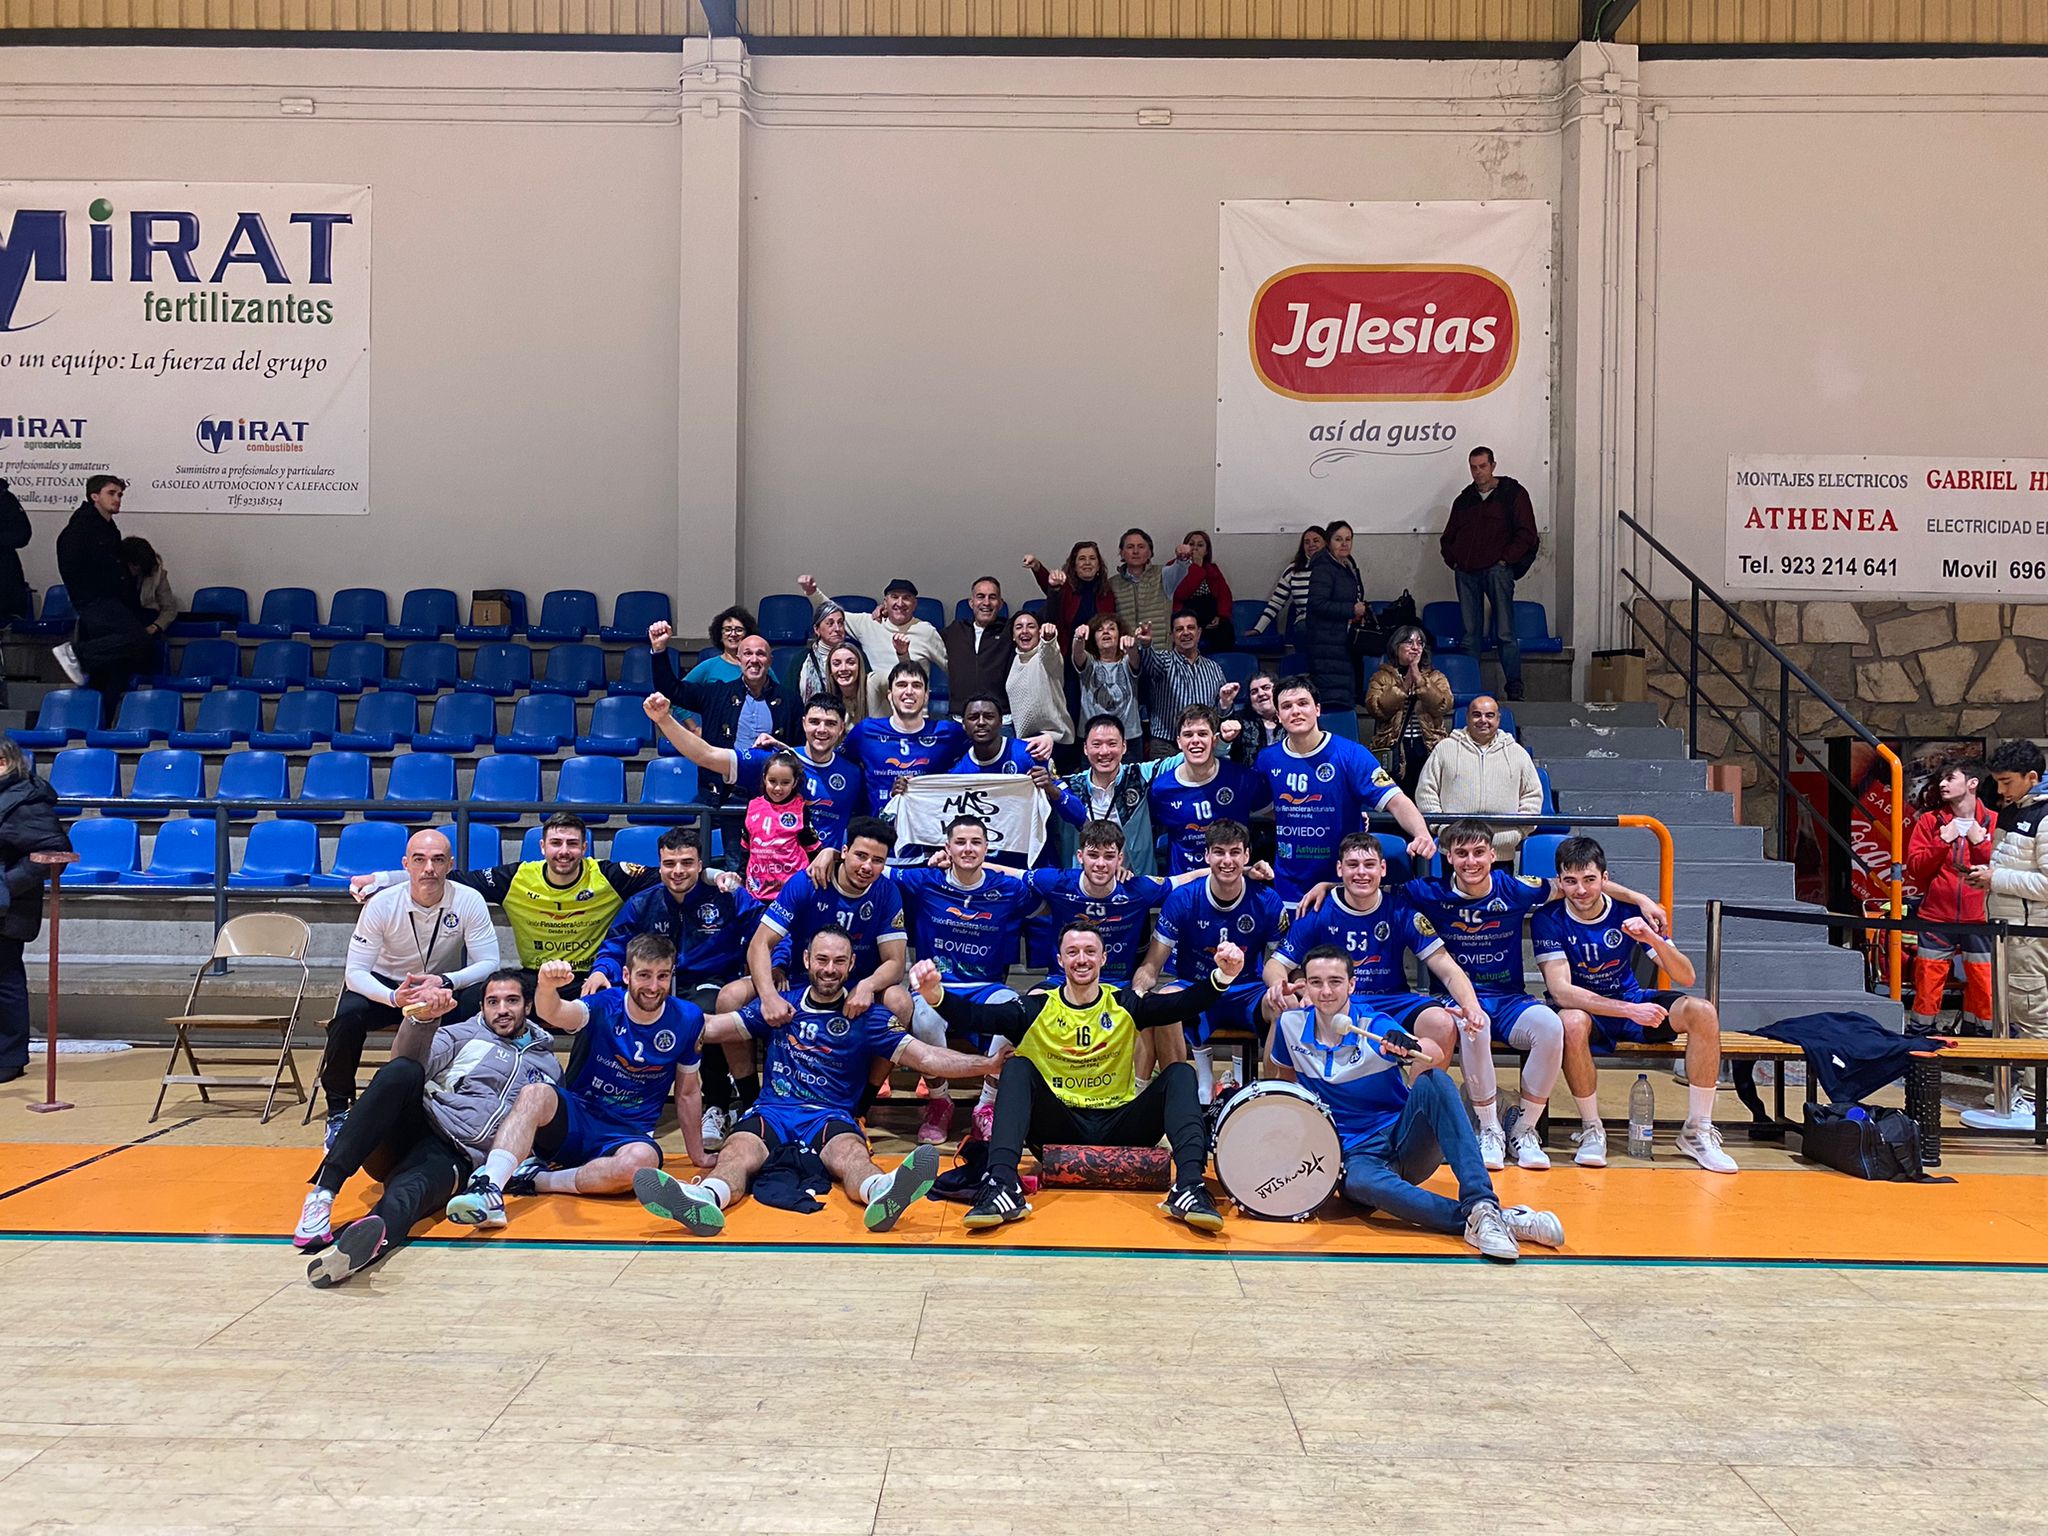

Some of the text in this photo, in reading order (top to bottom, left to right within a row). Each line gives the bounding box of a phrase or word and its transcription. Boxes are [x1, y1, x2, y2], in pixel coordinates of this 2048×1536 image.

[144, 290, 333, 325] fertilizantes
[20, 355, 46, 368] un
[52, 349, 126, 377] equipo:
[130, 352, 156, 371] La
[154, 350, 226, 377] fuerza
[232, 350, 260, 372] del
[264, 354, 328, 379] grupo
[1309, 420, 1457, 447] así da gusto
[246, 443, 303, 453] combustibles
[5, 460, 60, 473] profesionales
[60, 463, 68, 474] y
[69, 462, 110, 471] amateurs
[175, 465, 220, 474] Suministro
[227, 465, 279, 478] profesionales
[287, 466, 336, 478] particulares
[151, 480, 200, 490] GASOLEO
[202, 480, 275, 491] AUTOMOCION
[286, 481, 359, 492] CALEFACCION
[1737, 472, 1908, 489] MONTAJES ELECTRICOS
[1926, 470, 2018, 491] GABRIEL
[43, 494, 79, 505] 143-149
[244, 497, 283, 507] 923181524
[1745, 507, 1898, 532] ATHENEA
[1927, 518, 2031, 535] ELECTRICIDAD
[1739, 555, 1897, 577] Tel. 923 214 641
[1942, 560, 2046, 579] Movil 696
[900, 738, 910, 755] 5
[807, 778, 817, 797] 4
[1286, 773, 1308, 792] 46
[1193, 800, 1213, 820] 10
[762, 815, 773, 836] 4
[1282, 826, 1325, 837] OVIEDO
[753, 863, 793, 874] OVIEDO
[836, 911, 854, 931] 31
[545, 941, 592, 951] OVIEDO
[945, 941, 988, 957] OVIEDO
[1458, 951, 1504, 965] OVIEDO
[800, 1021, 819, 1040] 18
[1076, 1026, 1091, 1047] 16
[633, 1041, 645, 1063] 2
[1065, 1073, 1112, 1089] OVIEDO
